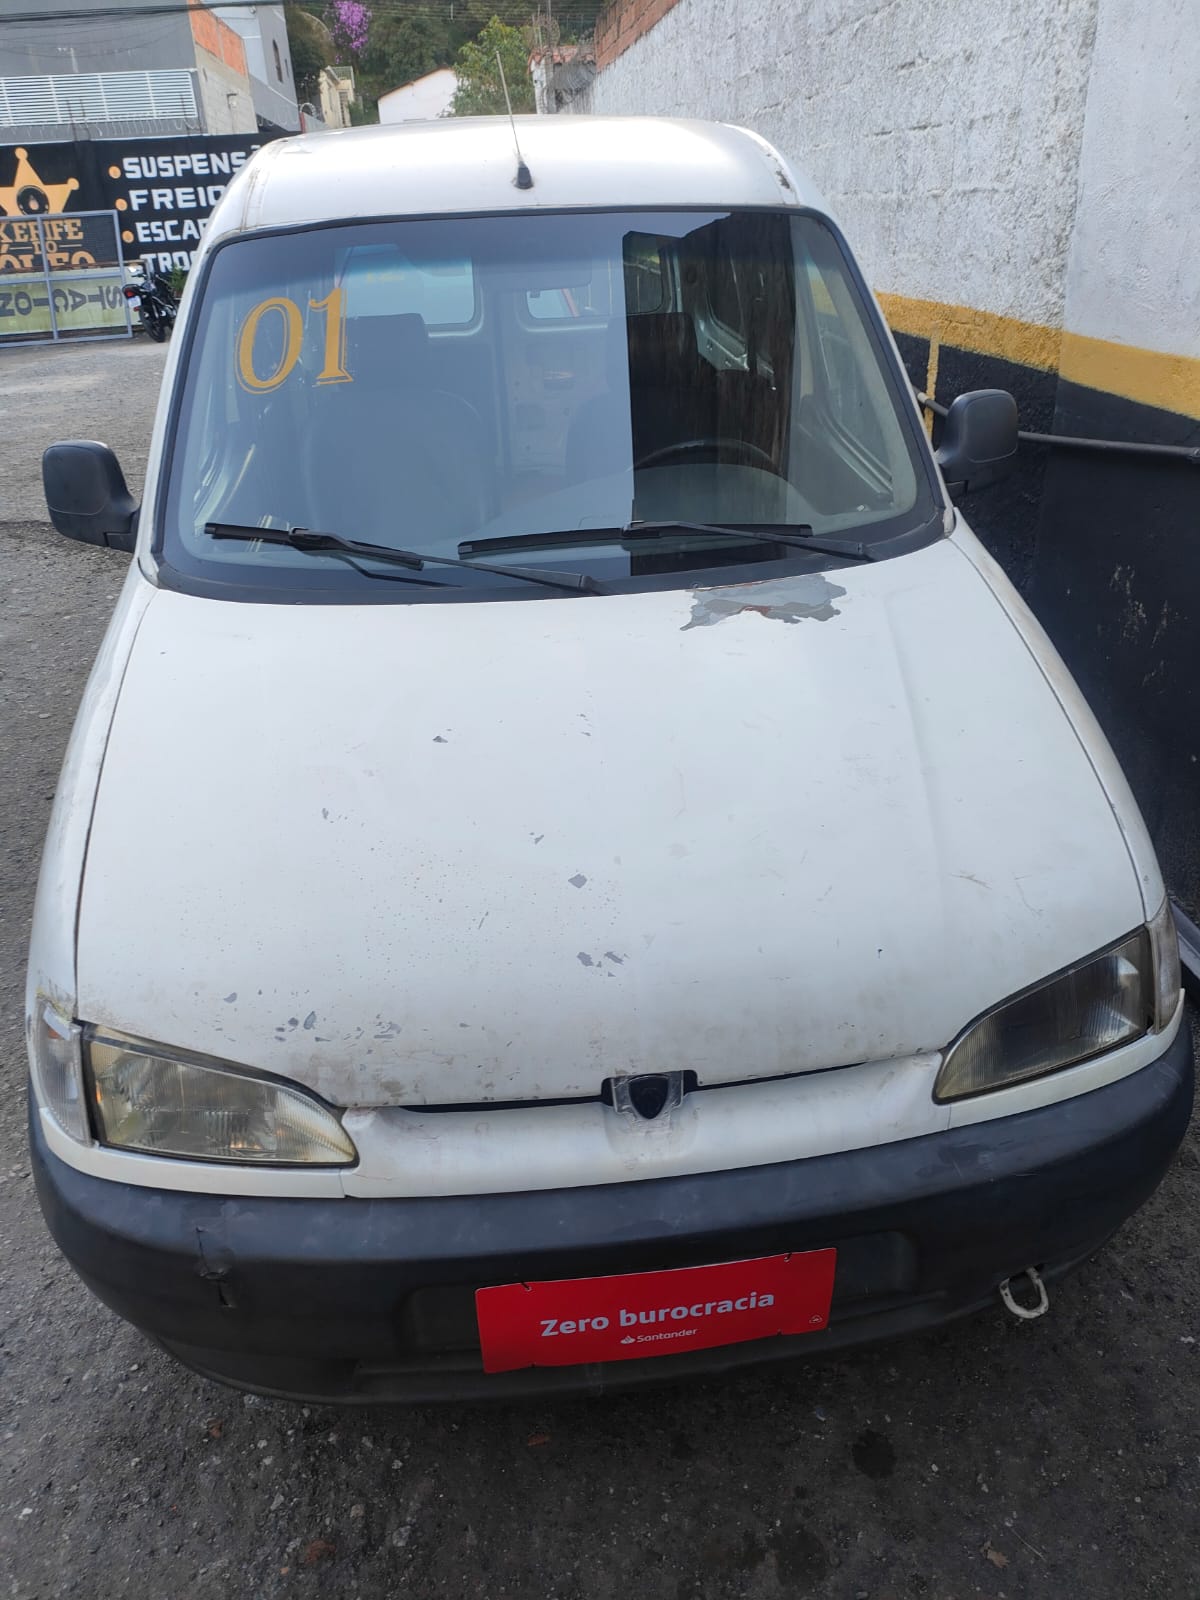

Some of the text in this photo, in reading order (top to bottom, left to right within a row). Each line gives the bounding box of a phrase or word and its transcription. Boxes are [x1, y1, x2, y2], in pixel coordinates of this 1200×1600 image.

[122, 146, 260, 179] SUSPENS
[235, 287, 353, 394] 01
[540, 1291, 775, 1337] Zero burocracia
[637, 1328, 698, 1343] Santander
